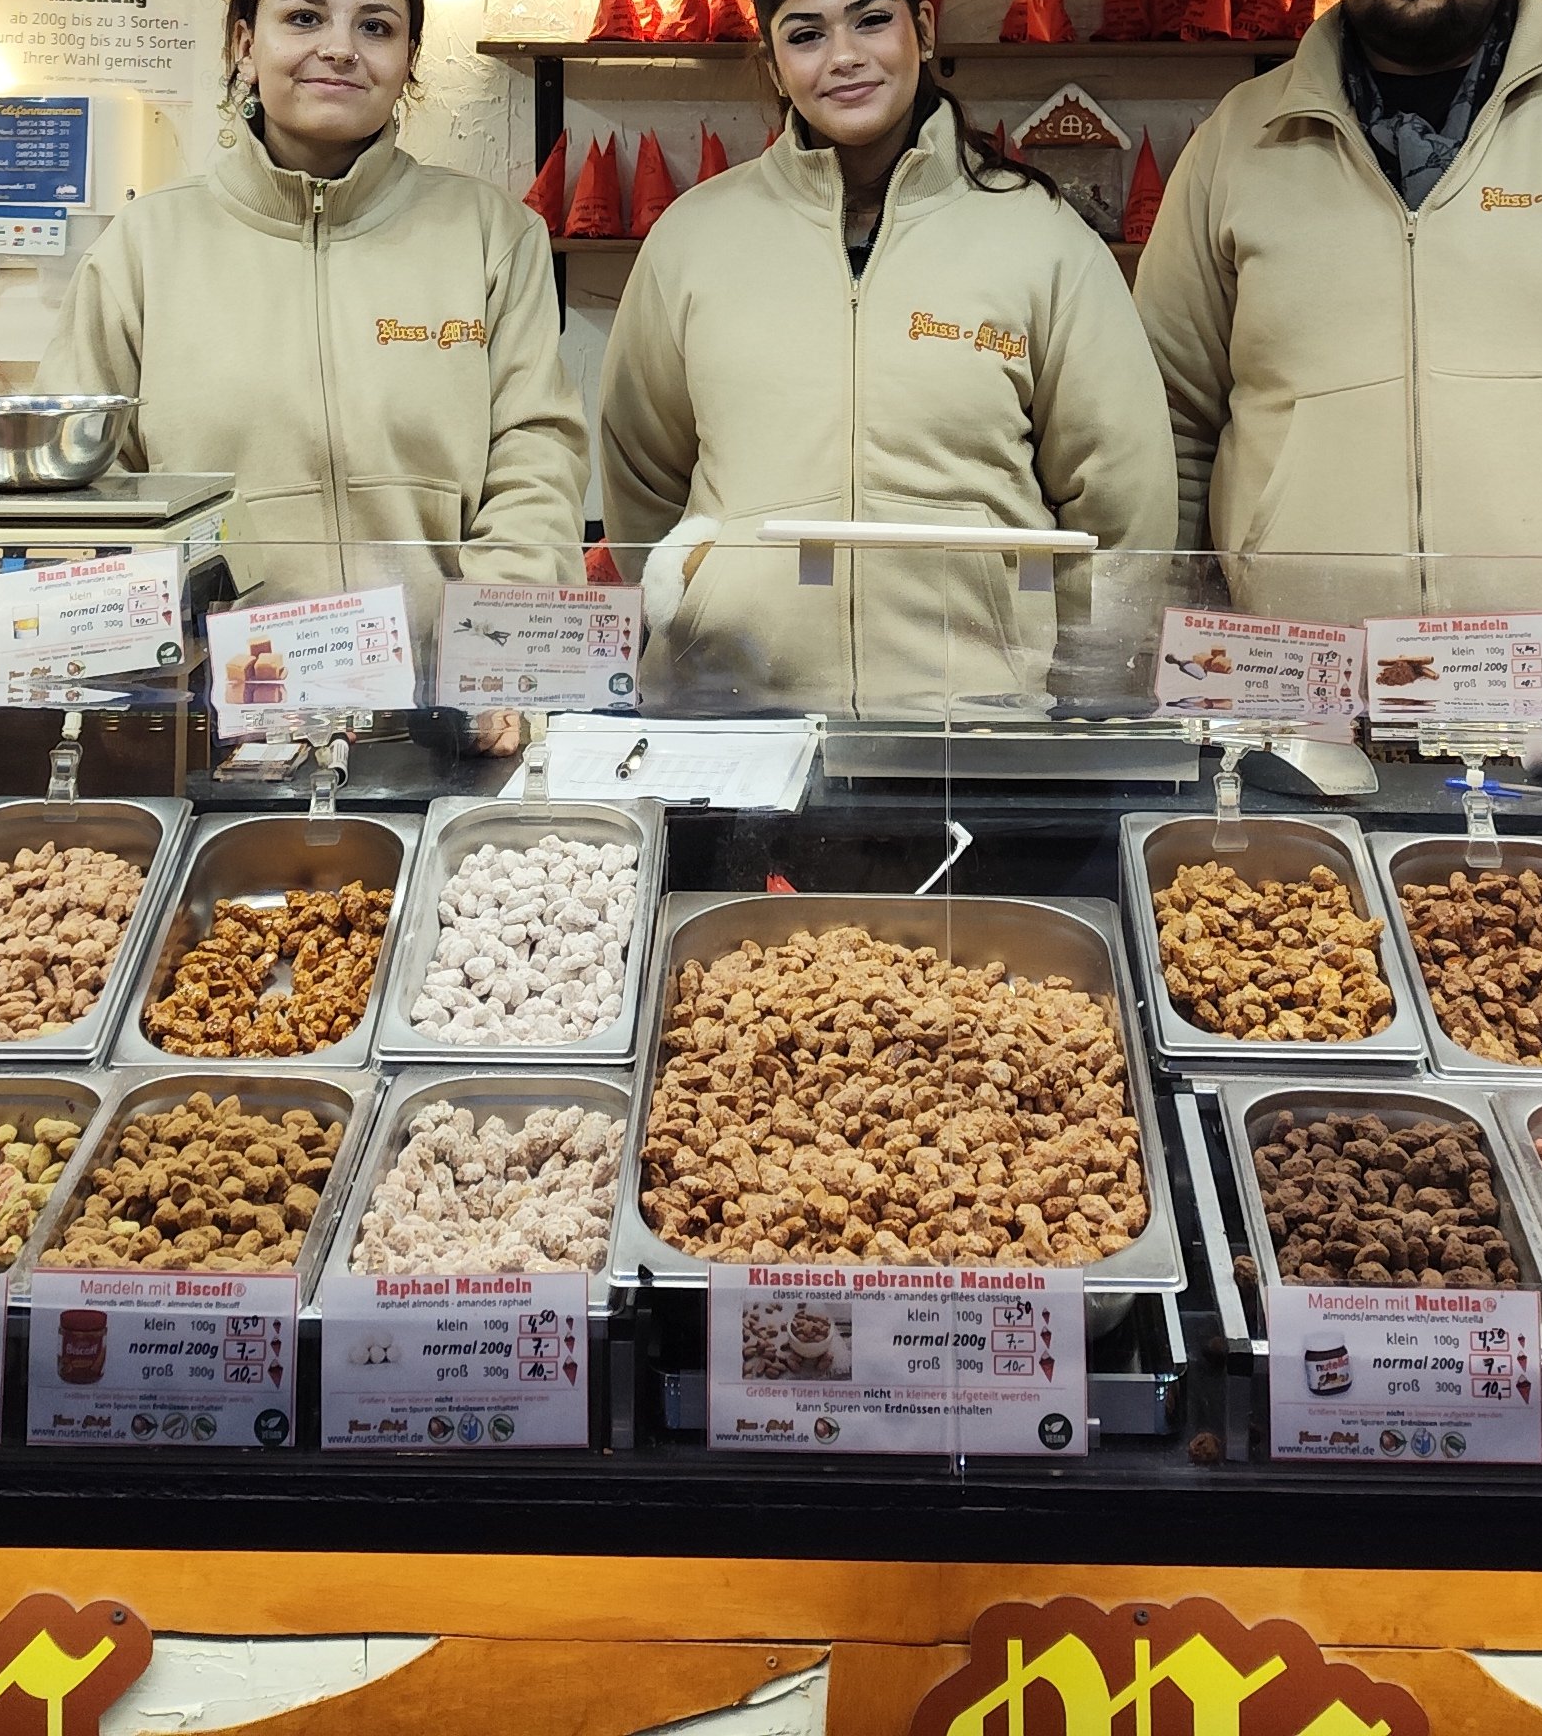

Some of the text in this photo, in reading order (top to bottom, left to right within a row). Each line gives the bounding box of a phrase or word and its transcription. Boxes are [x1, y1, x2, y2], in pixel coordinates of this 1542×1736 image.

[10, 13, 178, 29] ab 200g bis zu 3 Sorten
[28, 32, 46, 44] ab
[51, 33, 85, 48] 300g
[90, 35, 110, 47] bis
[115, 38, 131, 47] zu
[137, 37, 144, 47] 5
[24, 52, 172, 69] Ihrer Wahl gemischt
[1481, 187, 1532, 211] Nuss
[376, 319, 428, 345] Nuss
[909, 312, 960, 339] Nuss
[38, 562, 125, 582] Rum Mandeln
[480, 589, 606, 602] Mandeln mit Vanille
[250, 597, 362, 624] Karamell Mandeln
[1185, 616, 1346, 642] Salz Karamell Mandeln
[1419, 620, 1508, 633] Zimt Mandeln
[81, 1280, 143, 1294] Mandeln
[149, 1281, 171, 1295] mit
[376, 1278, 531, 1299] Raphael Mandeln
[748, 1269, 1045, 1291] Klassisch gebrannte Mandeln
[1308, 1294, 1379, 1310] Mandeln
[1386, 1295, 1409, 1310] mit
[907, 1308, 940, 1322] klein
[956, 1310, 982, 1325] 100g
[437, 1320, 467, 1331] klein
[483, 1320, 508, 1332] 100g
[423, 1341, 512, 1356] normal 200g
[893, 1333, 949, 1346] normal
[952, 1334, 986, 1350] 200g
[907, 1358, 983, 1373] groß 300g
[1373, 1356, 1464, 1373] normal 200g
[863, 1389, 891, 1399] nicht
[796, 1403, 821, 1412] kann
[824, 1403, 860, 1415] Spuren
[863, 1404, 882, 1413] von
[885, 1404, 940, 1414] Erdnüssen
